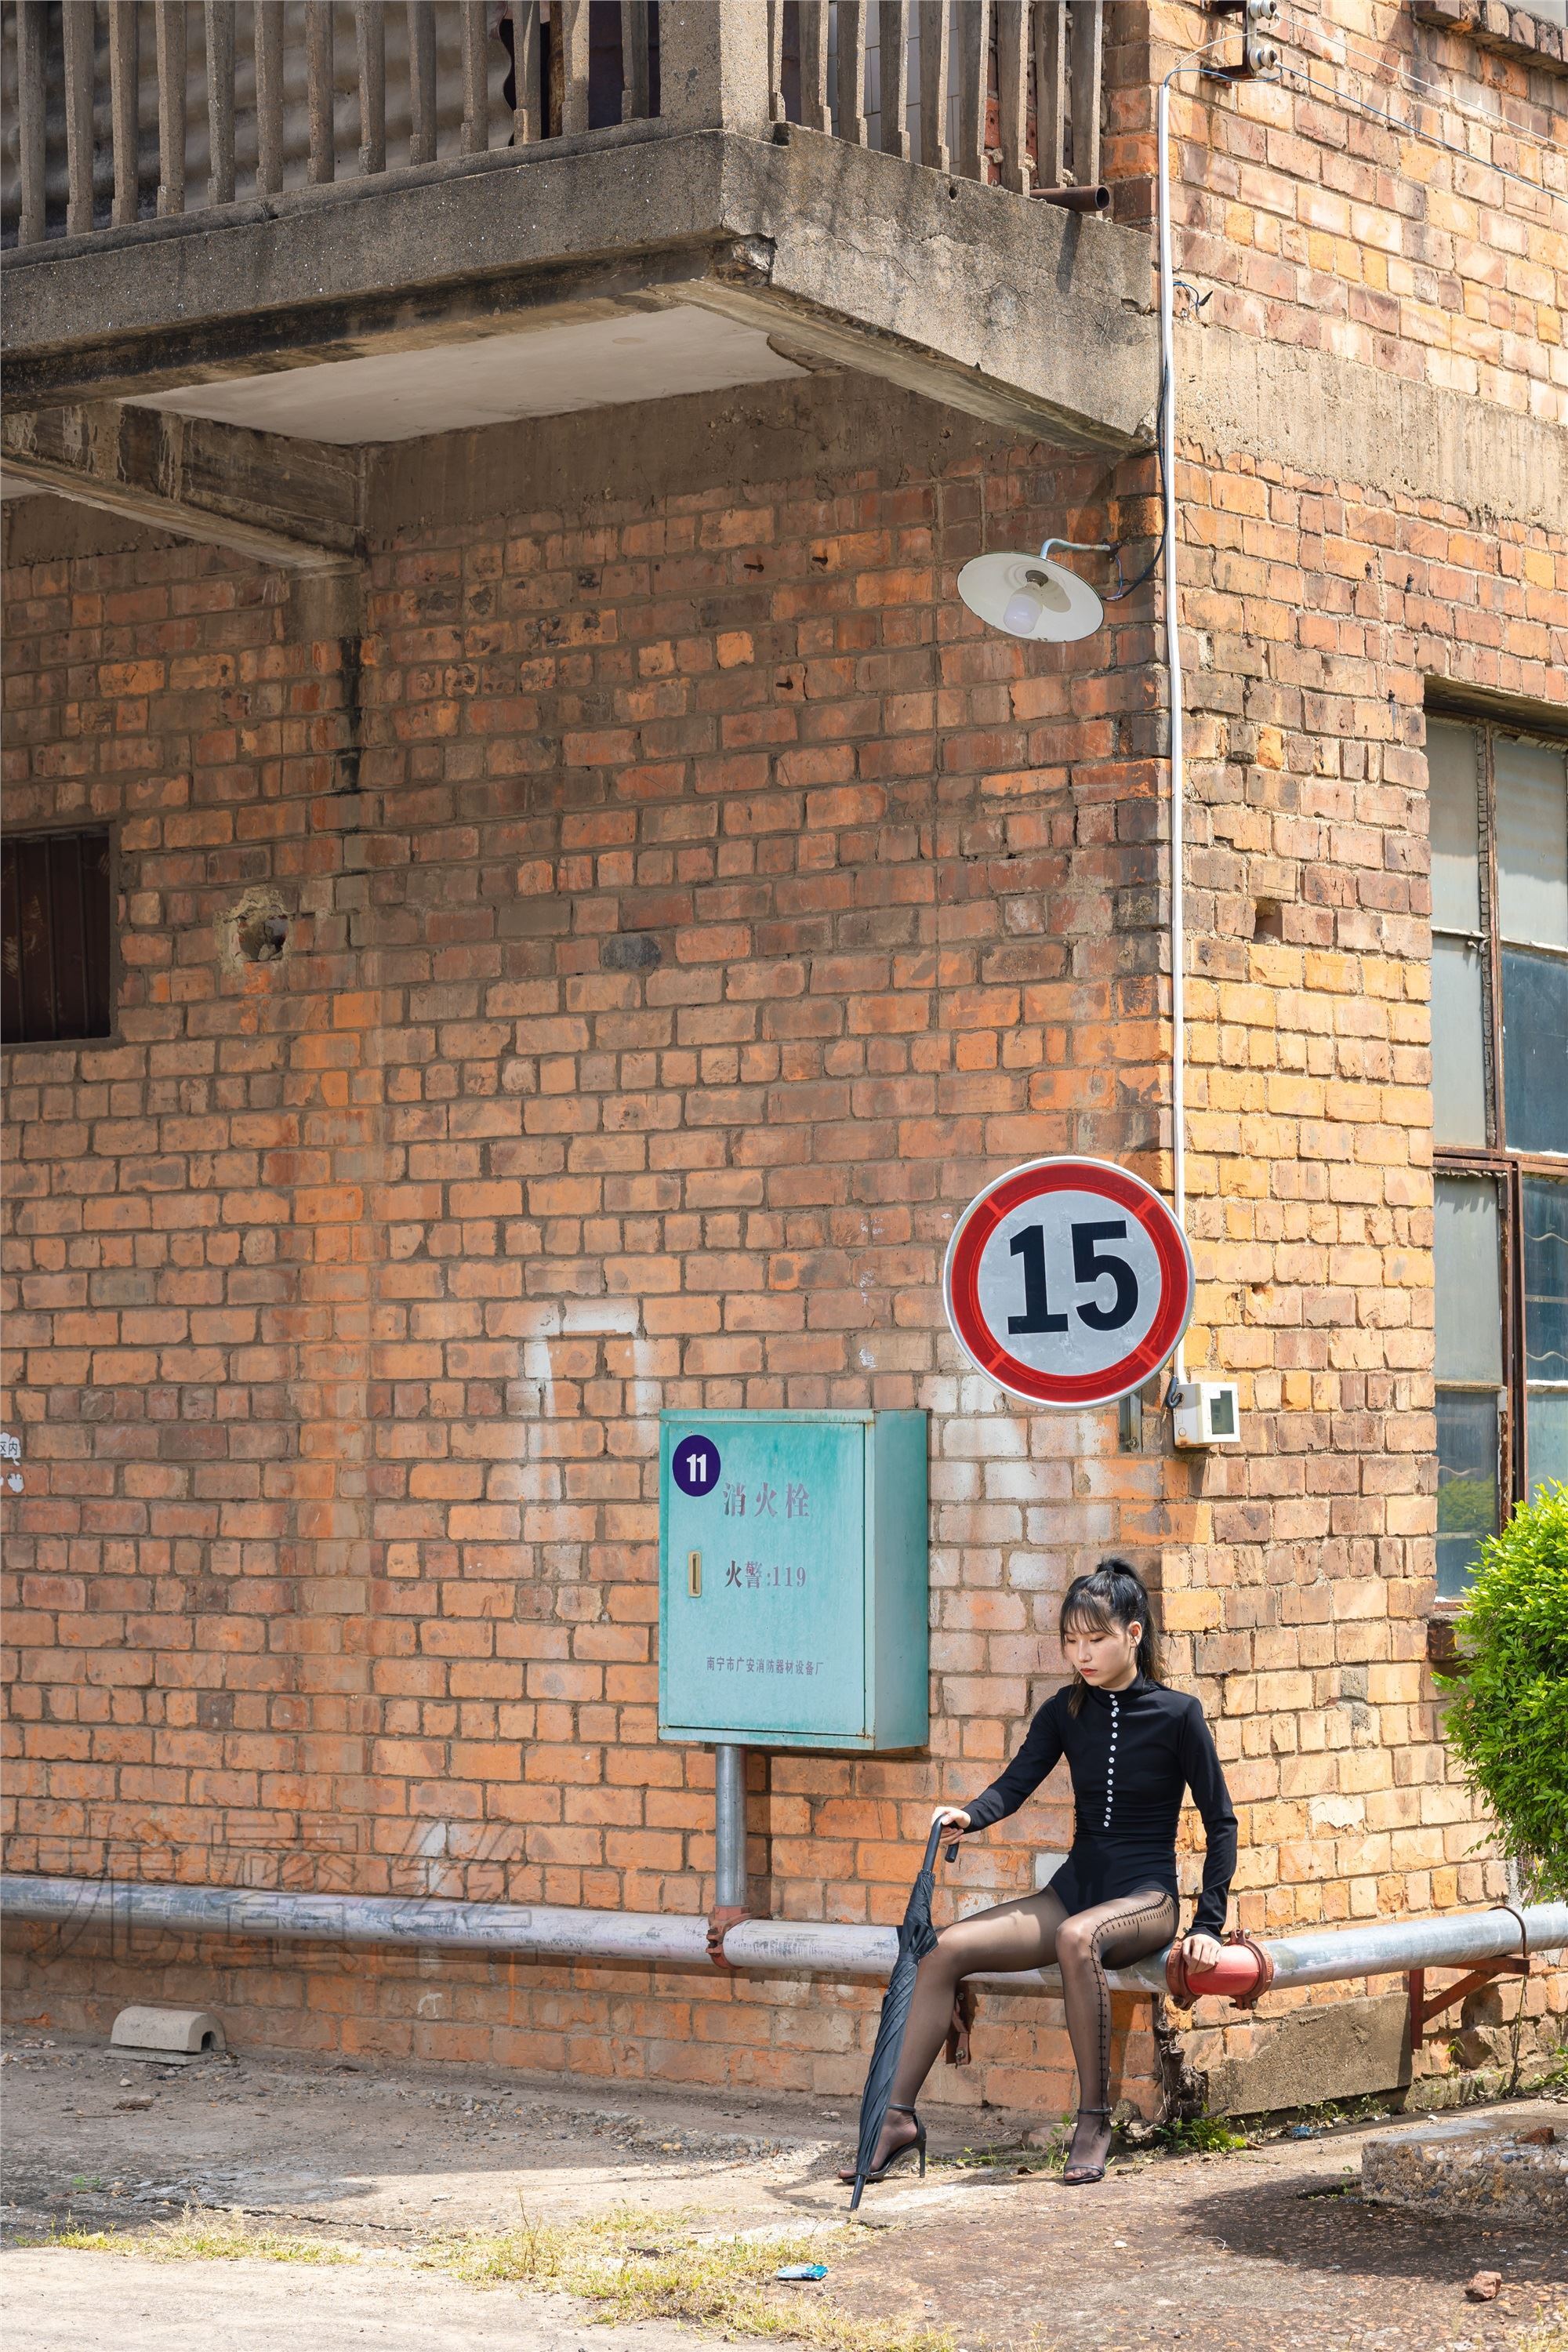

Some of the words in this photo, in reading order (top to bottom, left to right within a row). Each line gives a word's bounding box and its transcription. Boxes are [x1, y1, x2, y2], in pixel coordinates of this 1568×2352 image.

[1007, 1220, 1139, 1335] 15
[686, 1454, 706, 1482] 11
[722, 1481, 810, 1519] 消火栓
[706, 1656, 824, 1675] 南宁市广安消防器材设备厂
